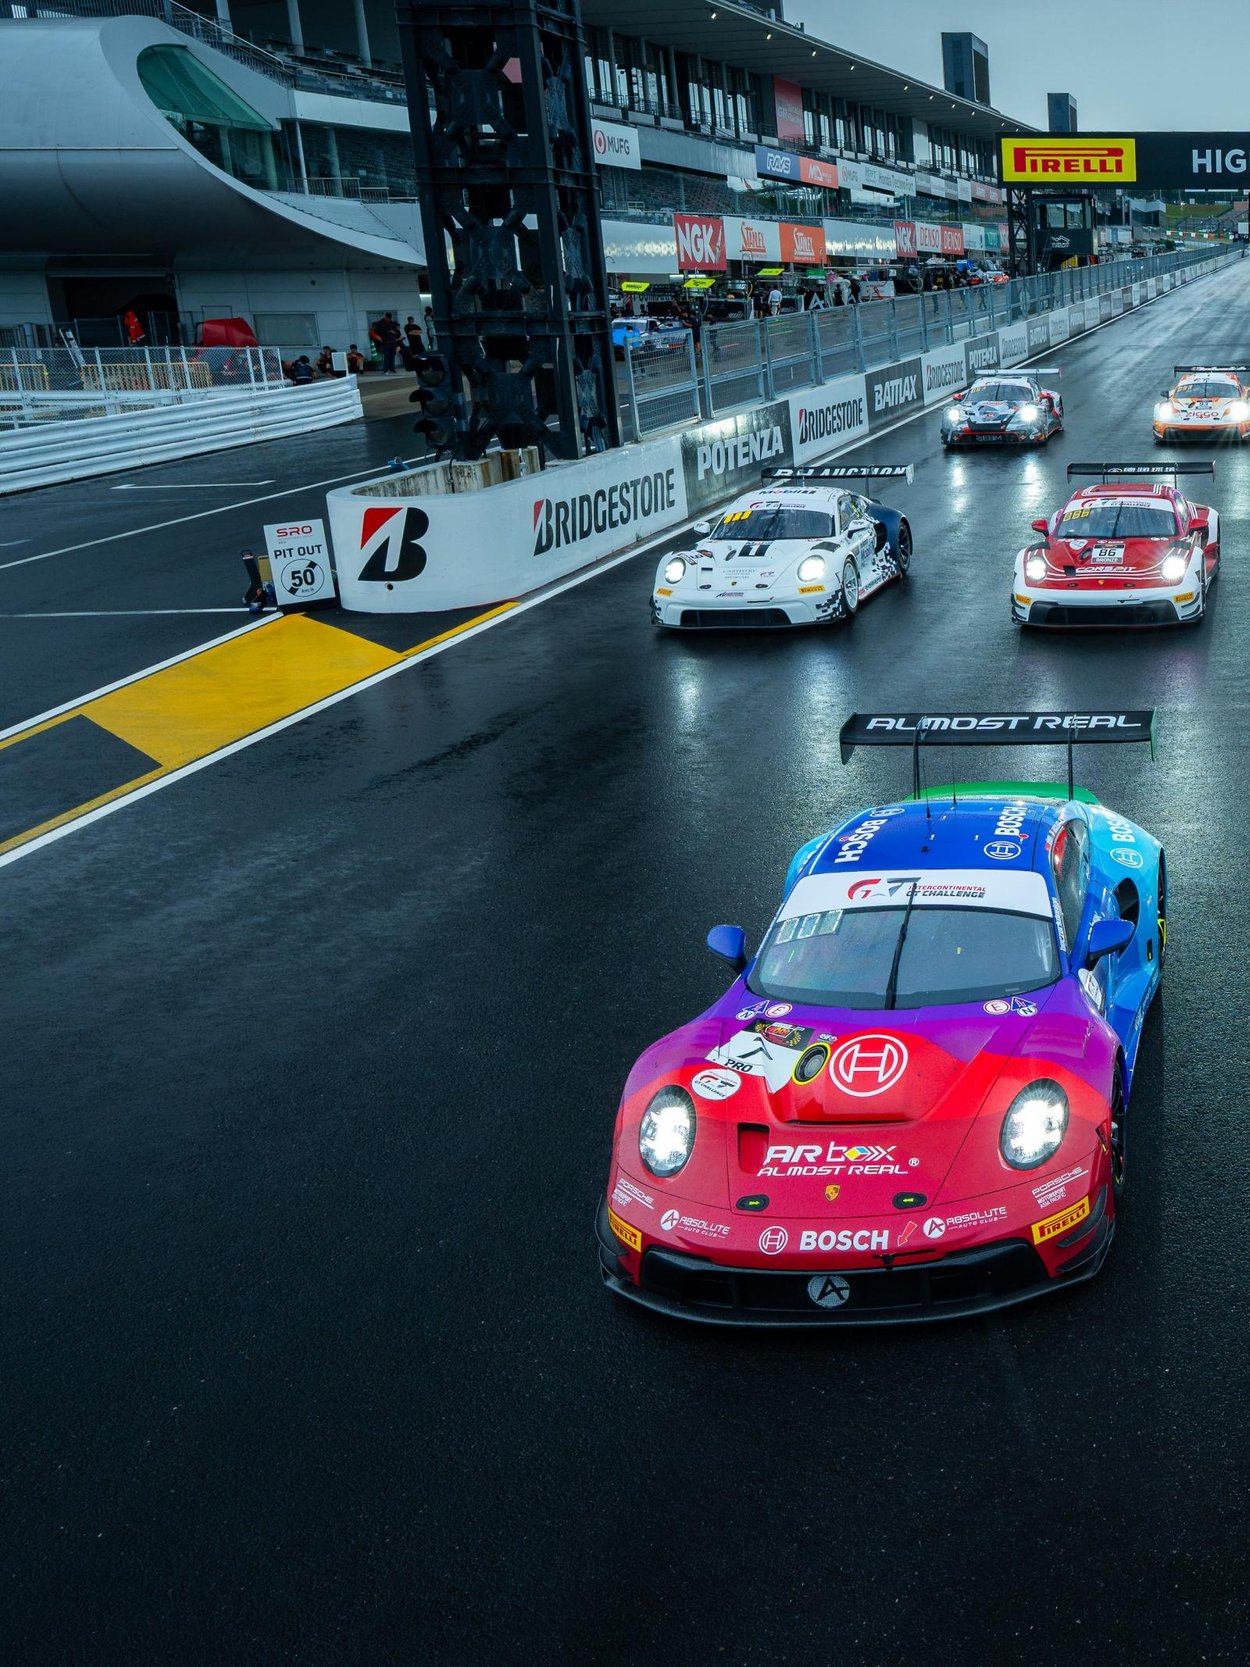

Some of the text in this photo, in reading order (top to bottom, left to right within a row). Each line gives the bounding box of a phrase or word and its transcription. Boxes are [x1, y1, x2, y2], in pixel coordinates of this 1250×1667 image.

[607, 135, 629, 155] MUFG
[766, 152, 791, 174] RAYS
[1013, 147, 1124, 173] PIRELLI
[677, 222, 716, 263] NGK
[740, 221, 766, 252] STANLEY
[792, 227, 815, 257] STANLEY
[895, 226, 912, 256] NGK
[919, 226, 940, 249] DENSO
[943, 229, 961, 251] DENSO
[969, 346, 998, 370] POTENZA
[926, 359, 964, 392] BRIDGESTONE
[873, 374, 918, 412] BATTLAX
[799, 397, 863, 444] BRIDGESTONE
[697, 425, 784, 481] POTENZA
[533, 468, 675, 557] BRIDGESTONE
[276, 525, 312, 537] SRO
[274, 545, 322, 559] PIT OUT
[291, 569, 315, 587] 50
[866, 715, 1142, 730] ALMOST REAL
[994, 806, 1028, 836] BOSCH
[834, 819, 888, 863] BOSCH
[922, 890, 986, 899] CHALLENGE
[724, 1058, 754, 1072] PRO
[757, 1164, 909, 1177] ALMOST REAL
[1032, 1166, 1083, 1195] PORSCHE
[619, 1178, 654, 1205] PORSCHE
[680, 1216, 731, 1235] ABSOLUTE
[946, 1207, 1007, 1226] ABSOLUTE
[958, 1216, 998, 1229] AUTO CLUB
[1039, 1203, 1085, 1238] PIRELLI
[701, 1230, 718, 1238] CLUB
[799, 1230, 888, 1250] BOSCH
